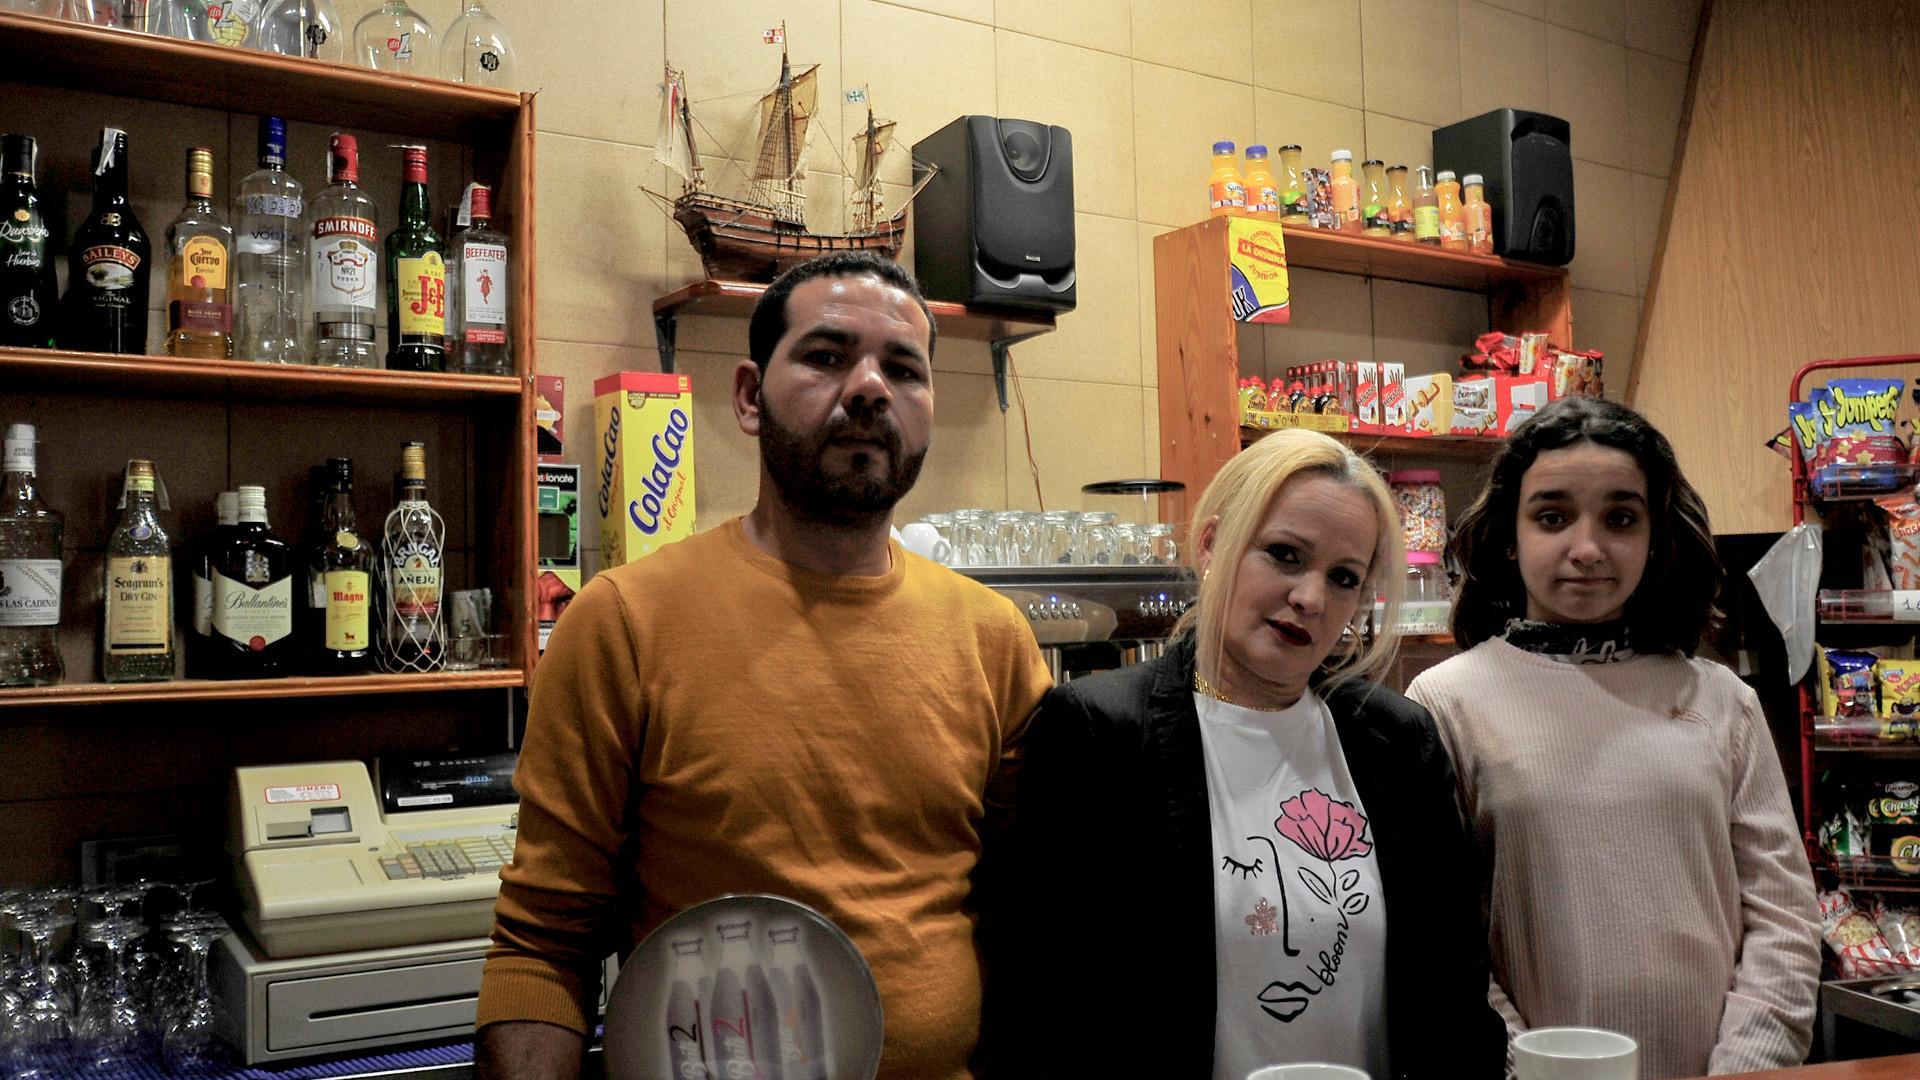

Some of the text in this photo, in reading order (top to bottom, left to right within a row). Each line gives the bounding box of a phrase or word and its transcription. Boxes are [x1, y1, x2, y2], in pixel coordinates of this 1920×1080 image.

[318, 220, 376, 238] SMIRNOFF
[82, 247, 138, 266] BAILEYS
[465, 247, 506, 260] BEEFEATER
[1242, 243, 1252, 254] LA
[190, 252, 220, 266] Cuervo
[1357, 384, 1377, 405] MIKADO
[1383, 385, 1405, 407] MIKADO
[629, 408, 689, 536] ColaCao
[396, 541, 440, 568] BRUGAL
[115, 577, 164, 591] Seagram's
[120, 591, 157, 601] DRY GIN
[333, 592, 363, 603] Magno
